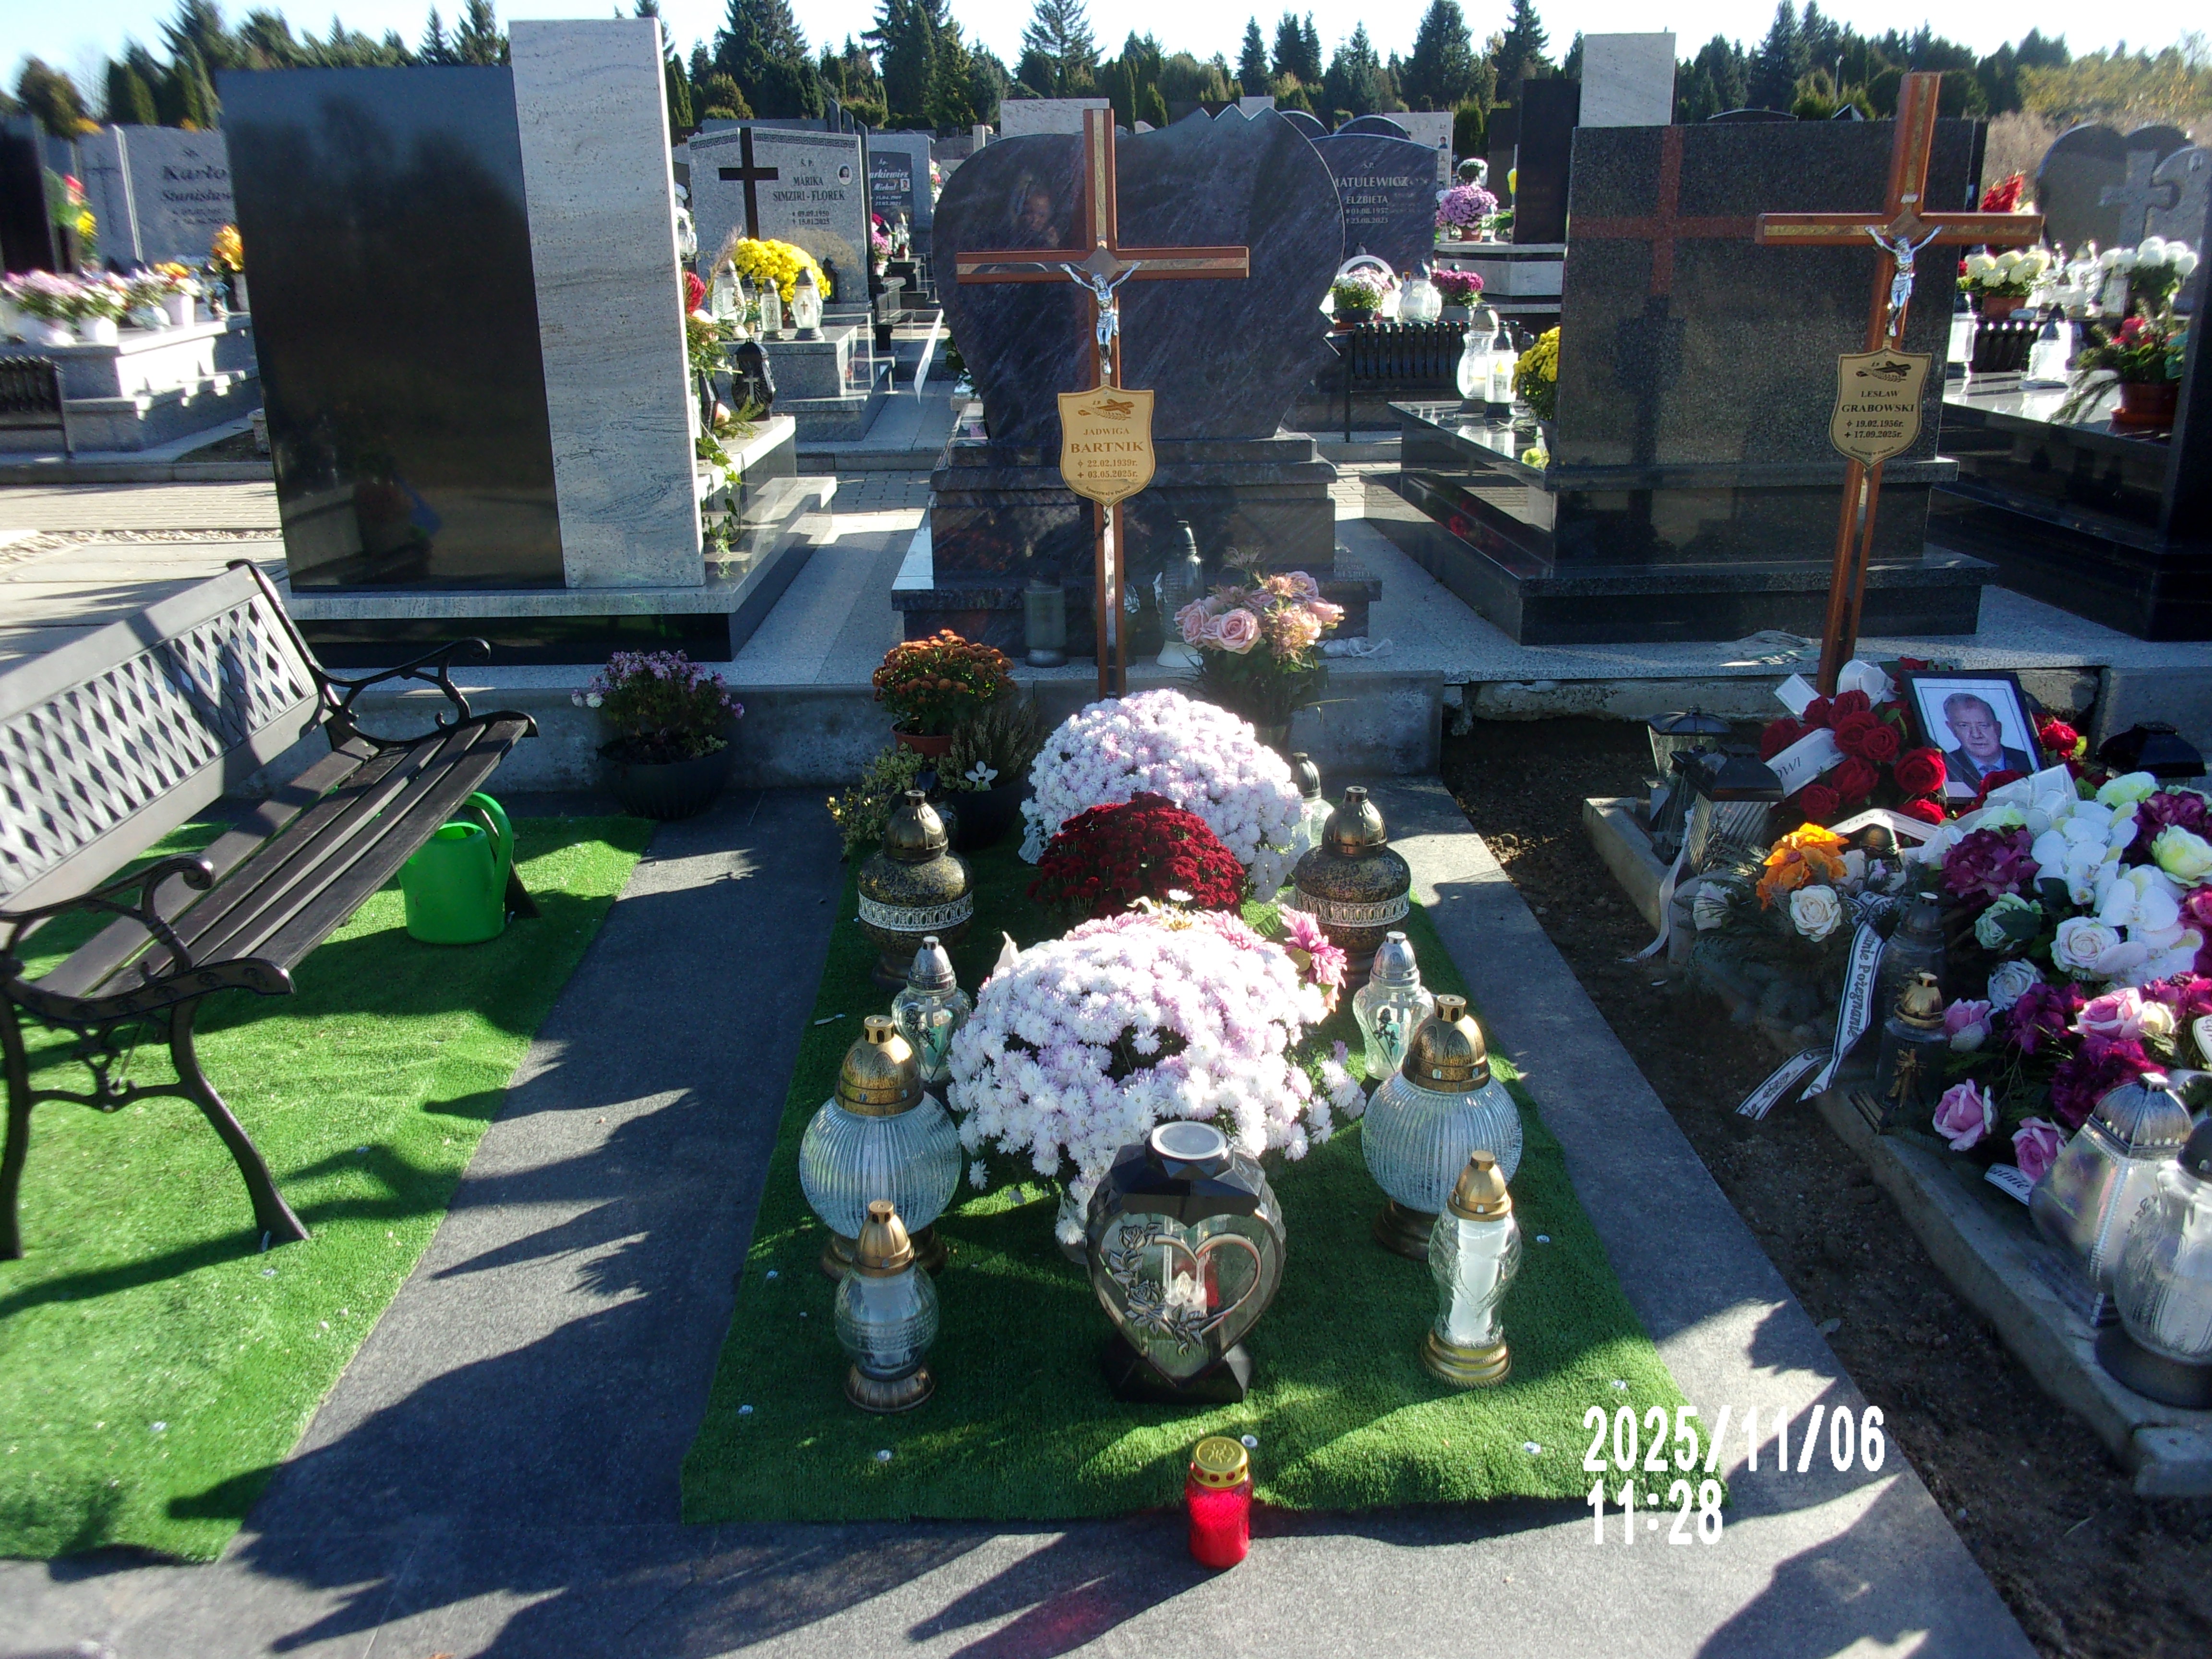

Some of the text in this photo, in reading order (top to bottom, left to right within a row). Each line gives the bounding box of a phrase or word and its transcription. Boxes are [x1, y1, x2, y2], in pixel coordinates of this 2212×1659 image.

[793, 177, 823, 186] MARIKA
[812, 191, 845, 201] FLOREK
[1841, 404, 1916, 413] GRABOWSKI
[1083, 428, 1130, 436] JADWIGA
[1071, 441, 1144, 454] BARTNIK
[1087, 459, 1138, 468] 22.02.1939r.
[1088, 470, 1138, 479] 03.05.2025r.
